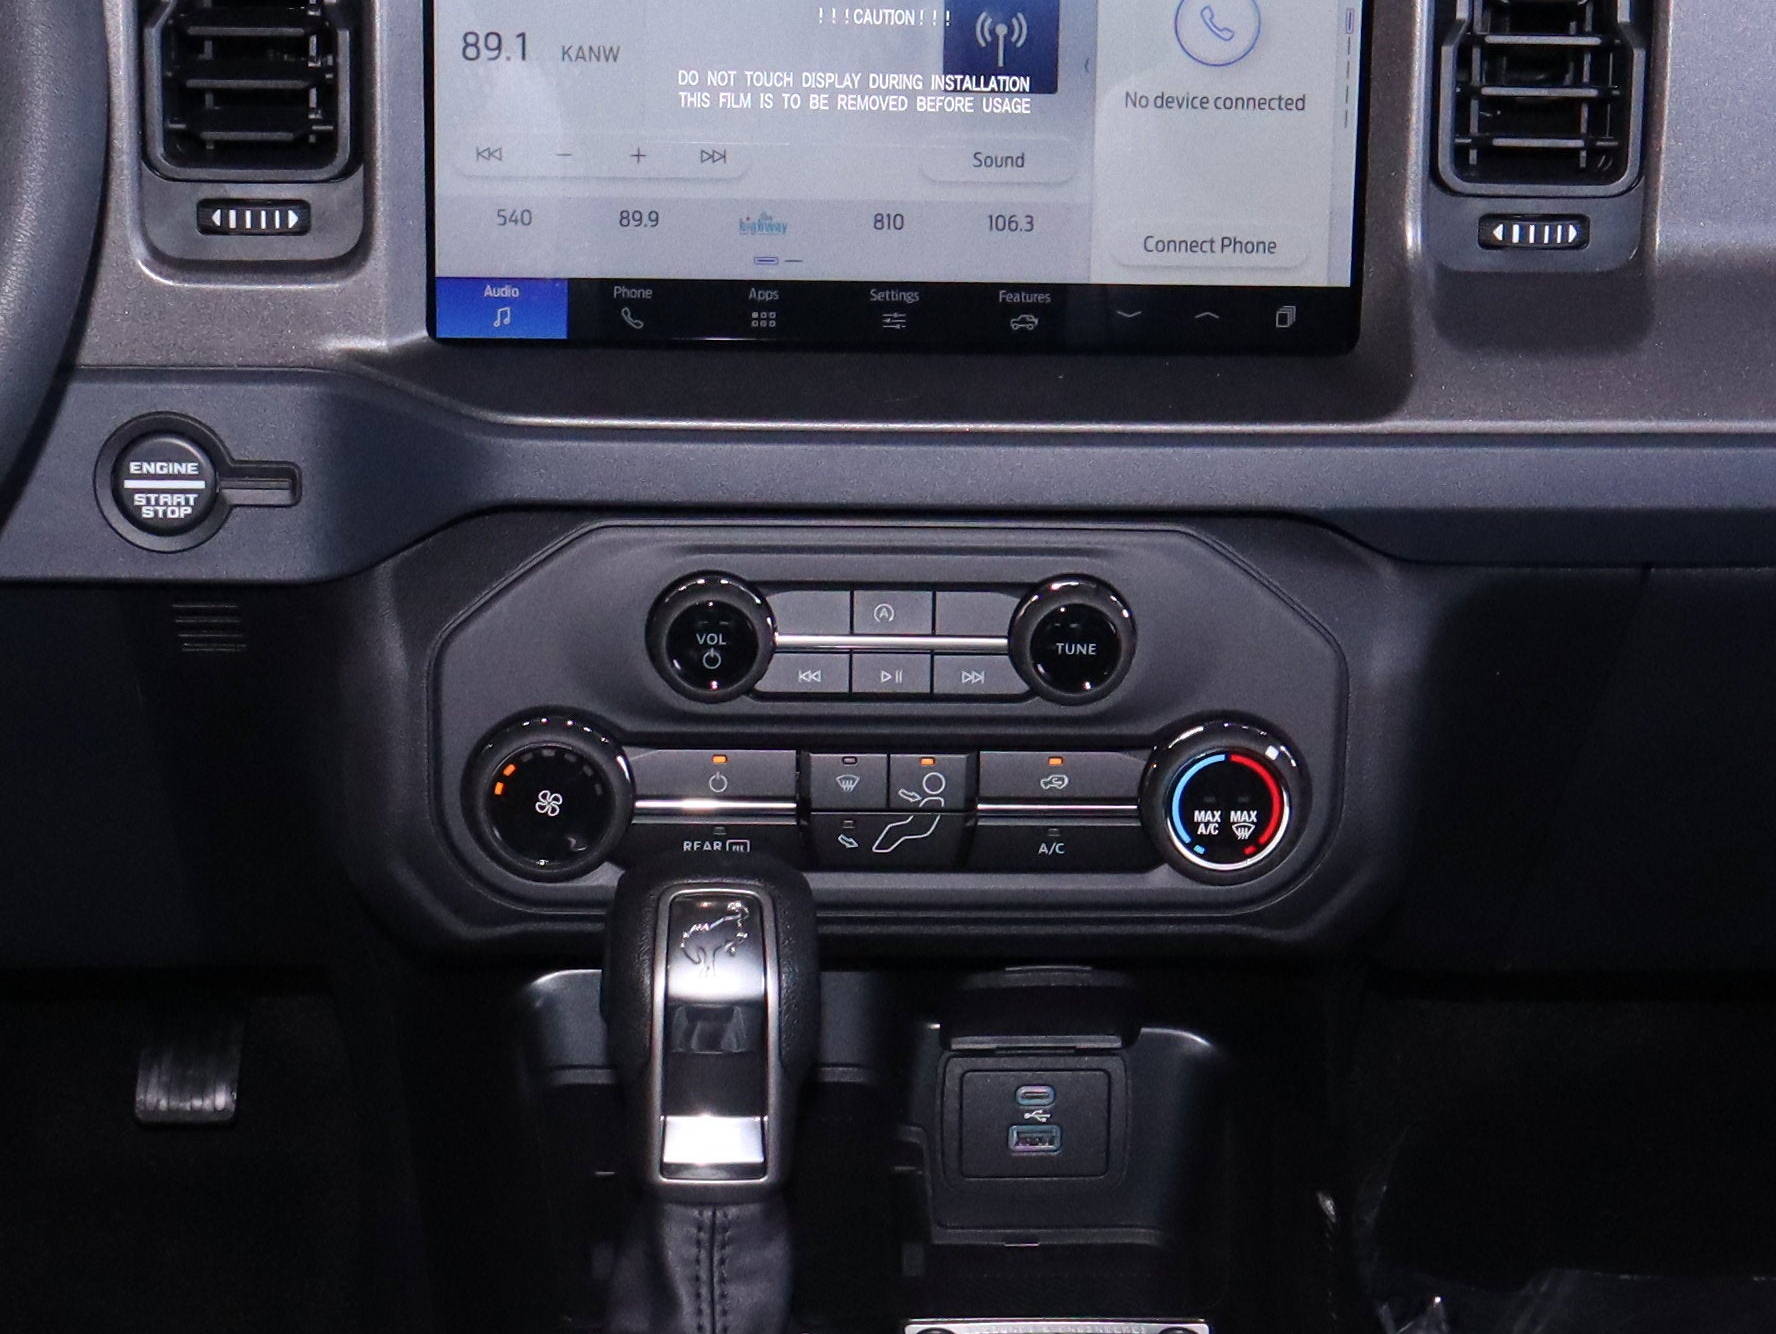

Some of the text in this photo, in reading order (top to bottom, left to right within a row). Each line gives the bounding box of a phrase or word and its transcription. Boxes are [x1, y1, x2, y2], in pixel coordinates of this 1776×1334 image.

[461, 30, 622, 65] 89.1 KANW
[678, 70, 1031, 92] DO NOT TOUCH DISPLAY DURING INSTALLATION
[678, 92, 1031, 114] THIS FILM IS TO BE REMOVED BEFORE USAGE
[1124, 91, 1307, 113] No device connected
[973, 152, 1025, 168] Sound
[495, 208, 533, 229] 540
[618, 209, 661, 230] 89.9
[872, 214, 905, 231] 810
[987, 214, 1035, 233] 106.3
[1143, 234, 1278, 257] Connect Phone
[482, 283, 520, 300] Audio
[612, 284, 654, 303] Phone
[747, 287, 781, 306] Apps
[868, 287, 921, 306] Settings
[997, 288, 1052, 306] Features
[129, 461, 199, 475] ENGINE
[134, 493, 198, 506] START
[141, 506, 192, 519] STOP
[695, 631, 727, 647] VOL
[1055, 641, 1097, 657] TUNE
[1194, 810, 1221, 823] MAX
[1229, 810, 1257, 823] MAX
[1197, 823, 1219, 835] A/C
[1037, 840, 1065, 856] A/C
